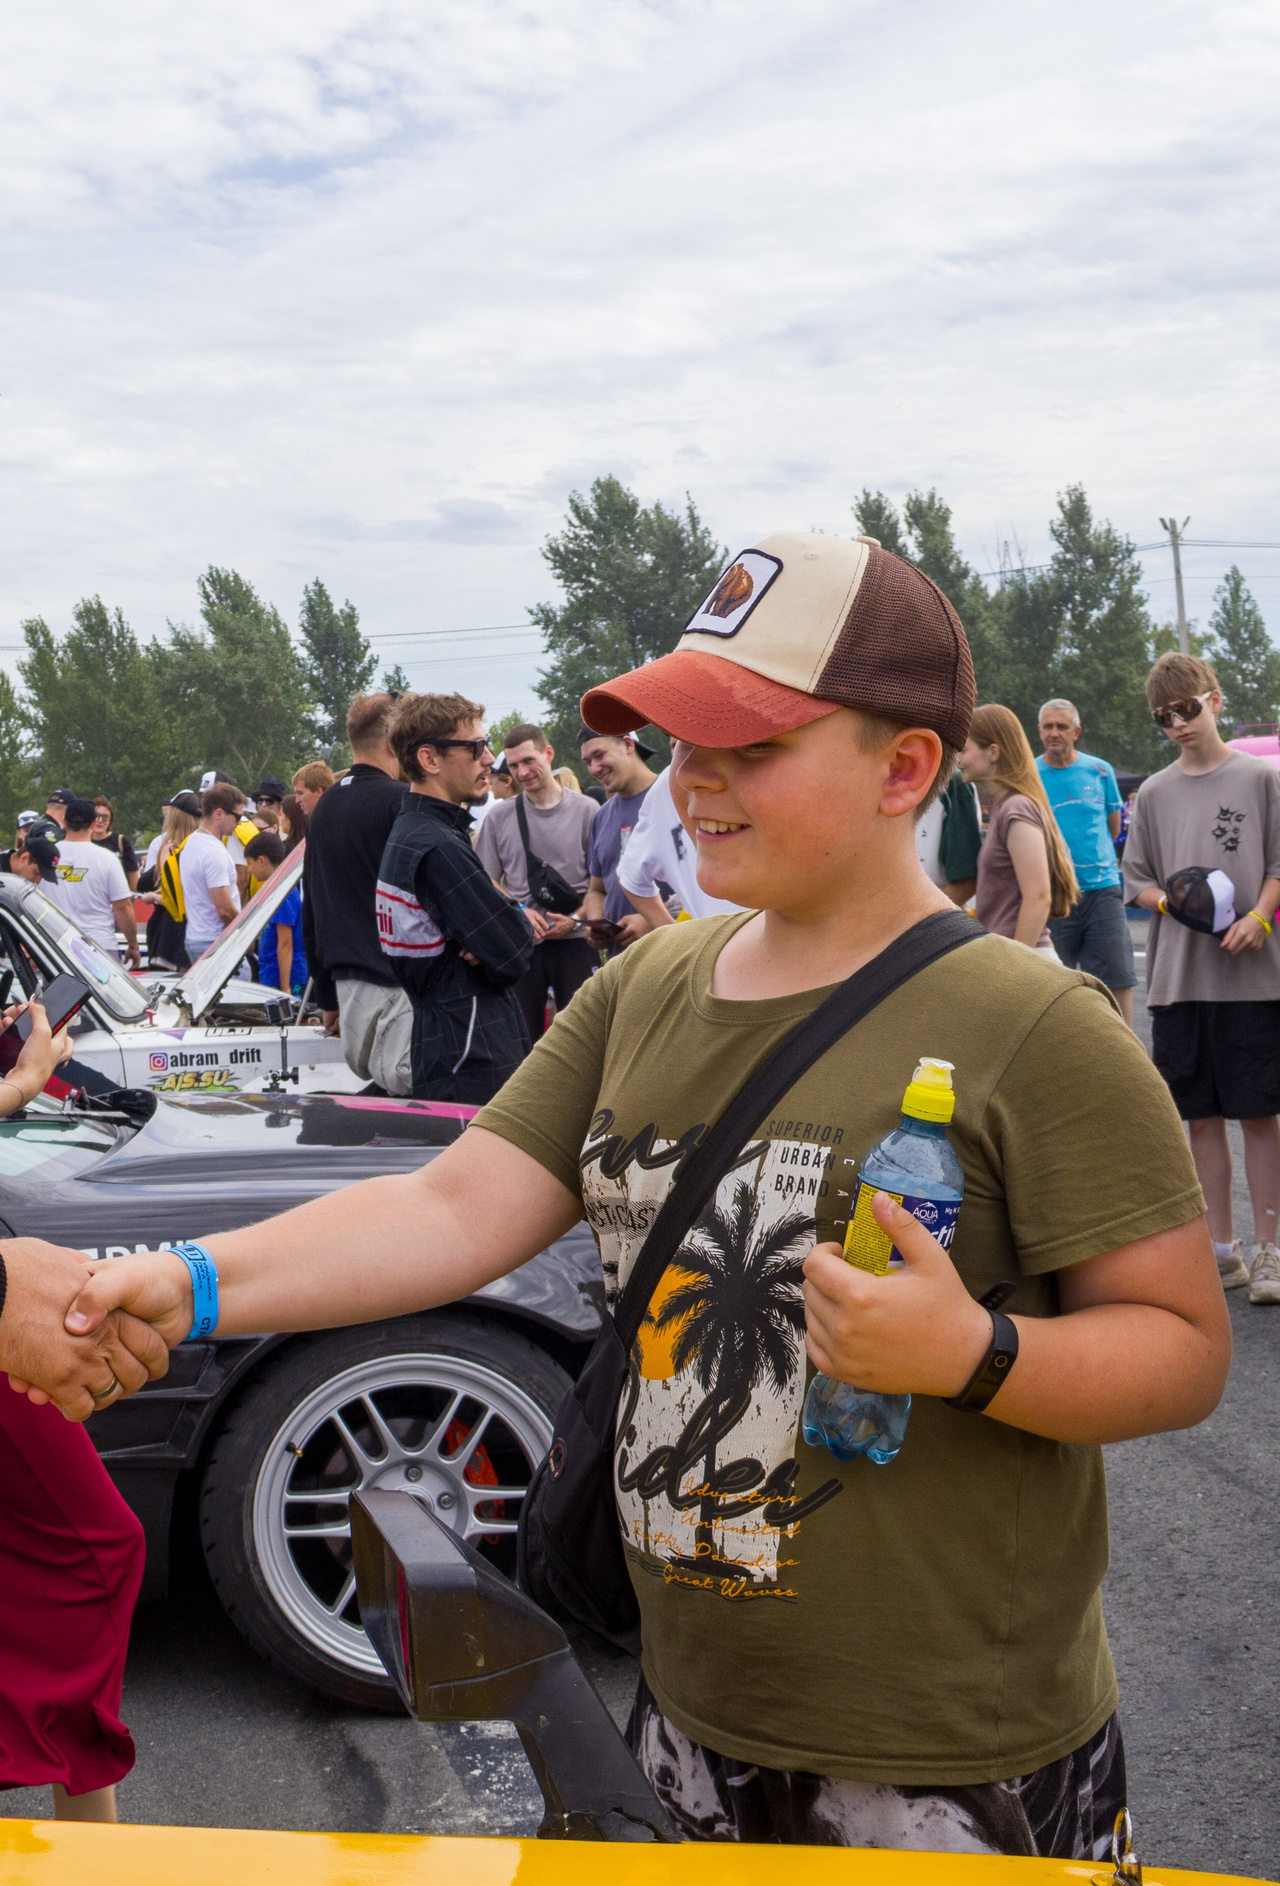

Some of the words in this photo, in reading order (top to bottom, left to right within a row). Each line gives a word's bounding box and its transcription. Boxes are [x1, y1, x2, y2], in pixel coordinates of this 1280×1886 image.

[170, 1048, 262, 1068] abram_drift
[767, 1119, 845, 1145] SUPERIOR
[780, 1146, 836, 1171] URBAN
[775, 1174, 830, 1198] BRAND
[913, 1207, 939, 1220] AQUA
[617, 1366, 844, 1530] ider
[682, 1476, 803, 1504] Adventure
[680, 1506, 801, 1537] Unlimited
[693, 1542, 801, 1568] Paradise
[662, 1563, 714, 1589] Great
[720, 1578, 799, 1598] Waves
